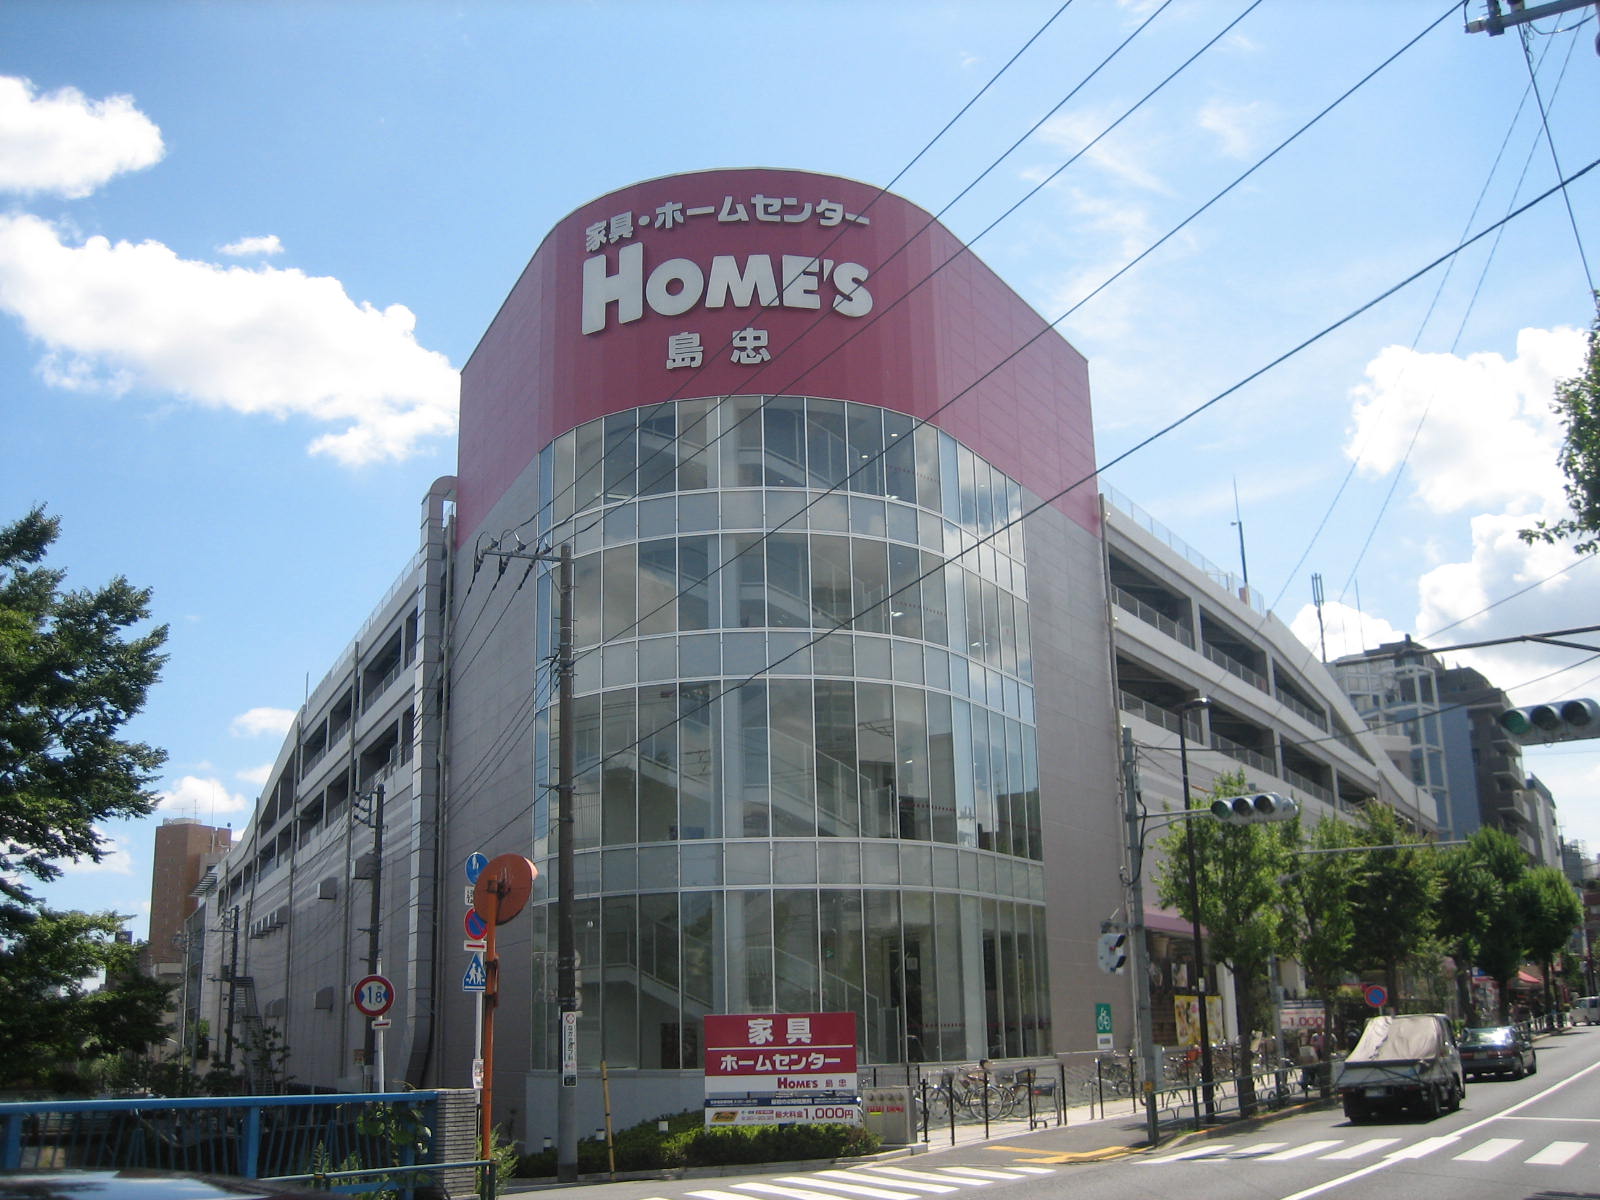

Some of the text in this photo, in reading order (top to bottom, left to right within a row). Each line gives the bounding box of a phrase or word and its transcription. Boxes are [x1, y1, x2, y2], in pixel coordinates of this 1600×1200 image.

[585, 194, 870, 253] 家具・ホームセンター
[582, 241, 873, 335] HOME'S
[666, 327, 771, 370] 島忠
[747, 1017, 812, 1045] 家具
[720, 1052, 840, 1072] ホームセンター
[777, 1077, 818, 1089] HOME'S
